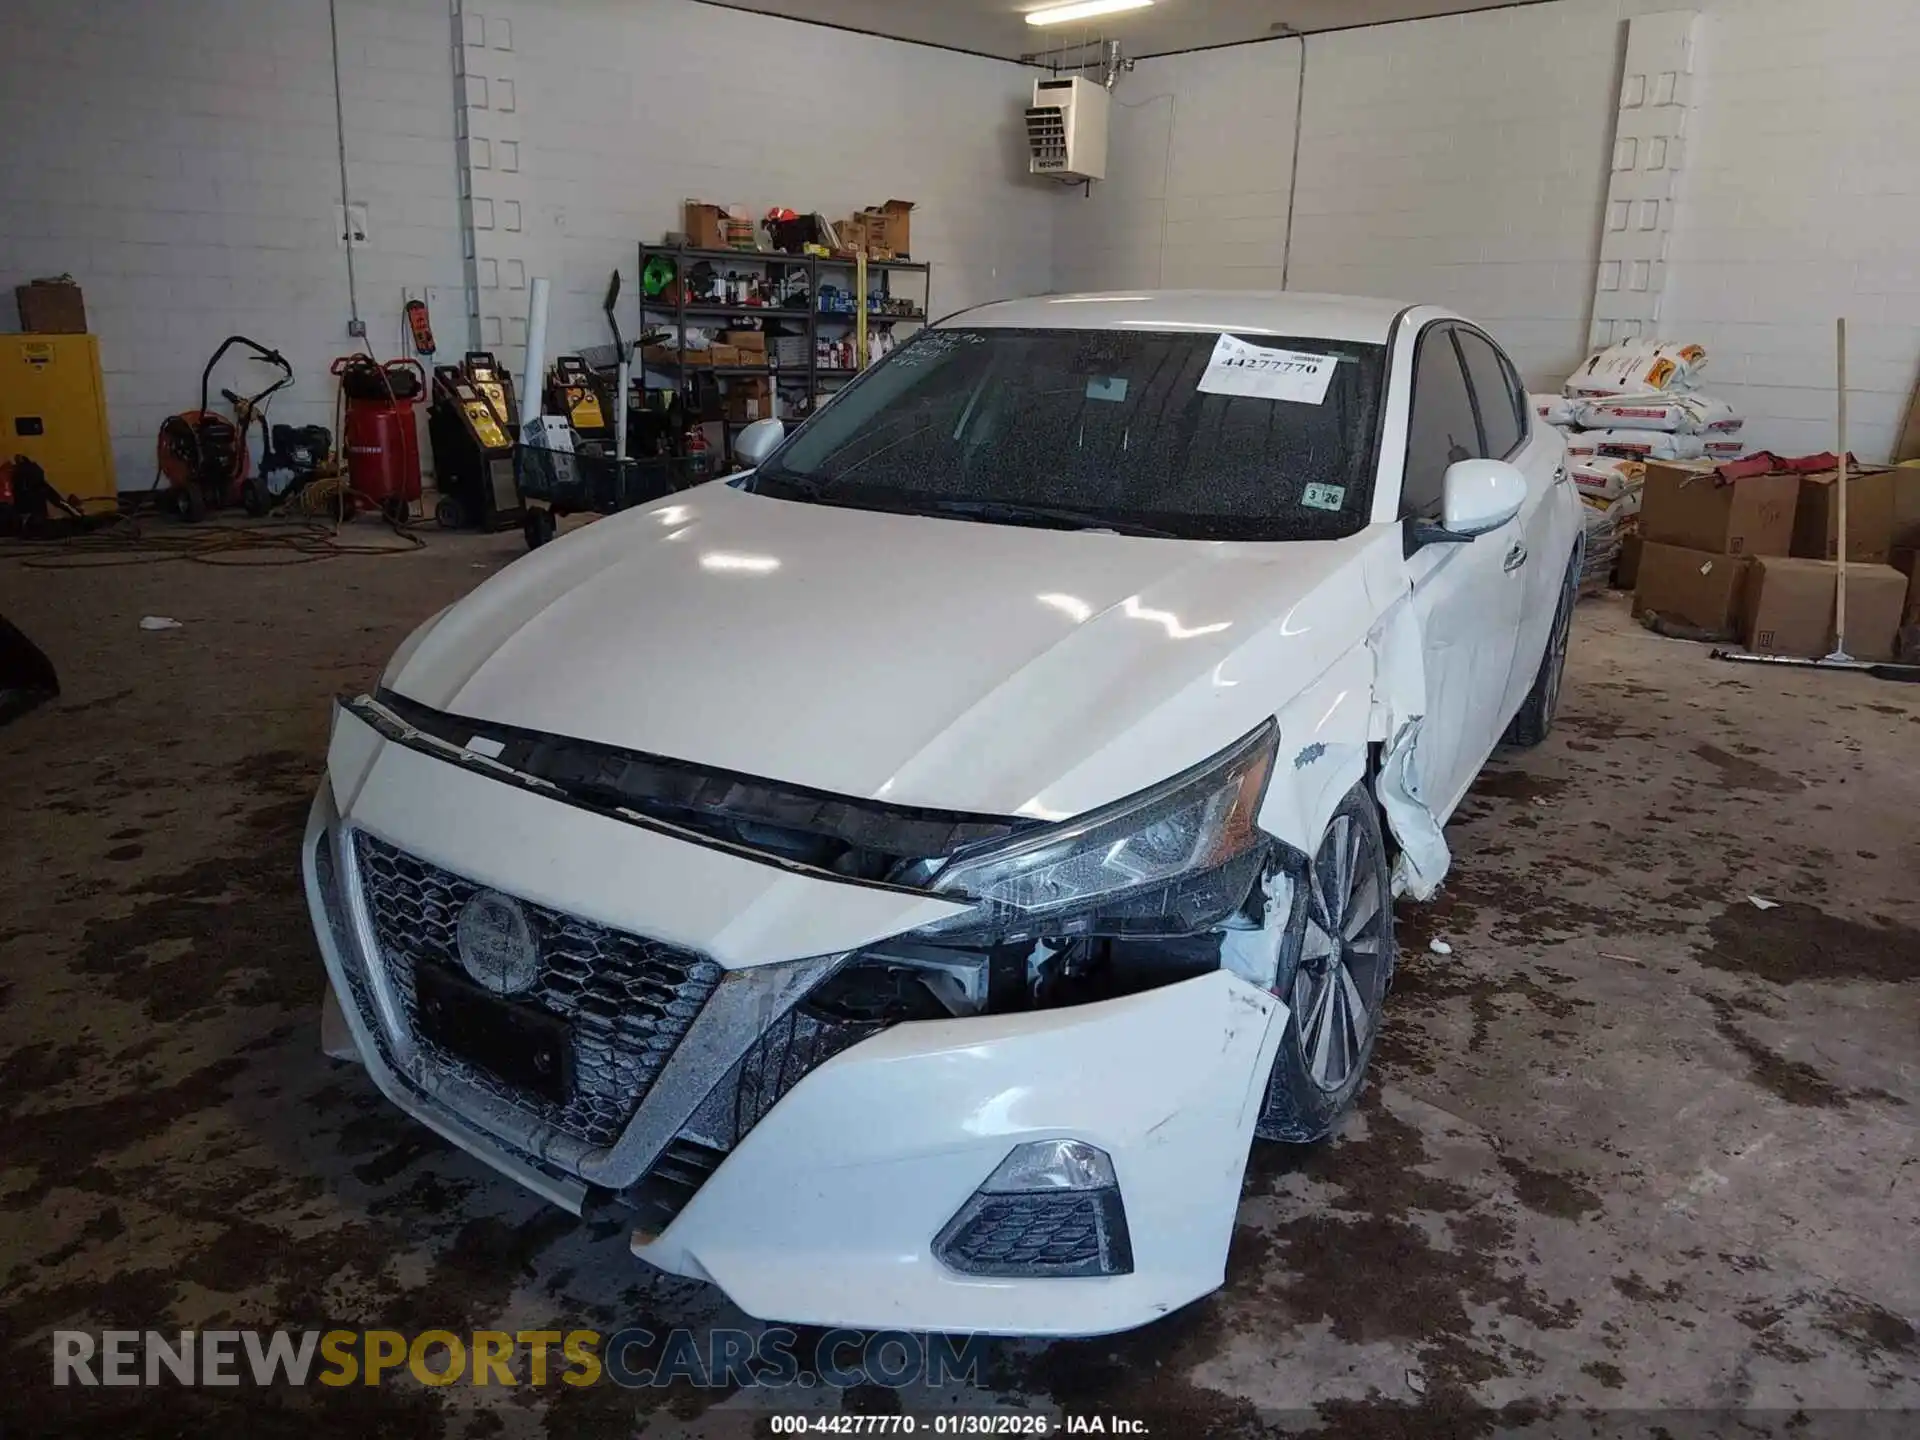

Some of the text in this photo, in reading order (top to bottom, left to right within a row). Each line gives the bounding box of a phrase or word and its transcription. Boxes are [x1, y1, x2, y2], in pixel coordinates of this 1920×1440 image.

[1222, 357, 1318, 375] 44277770
[1309, 489, 1339, 505] 3 26
